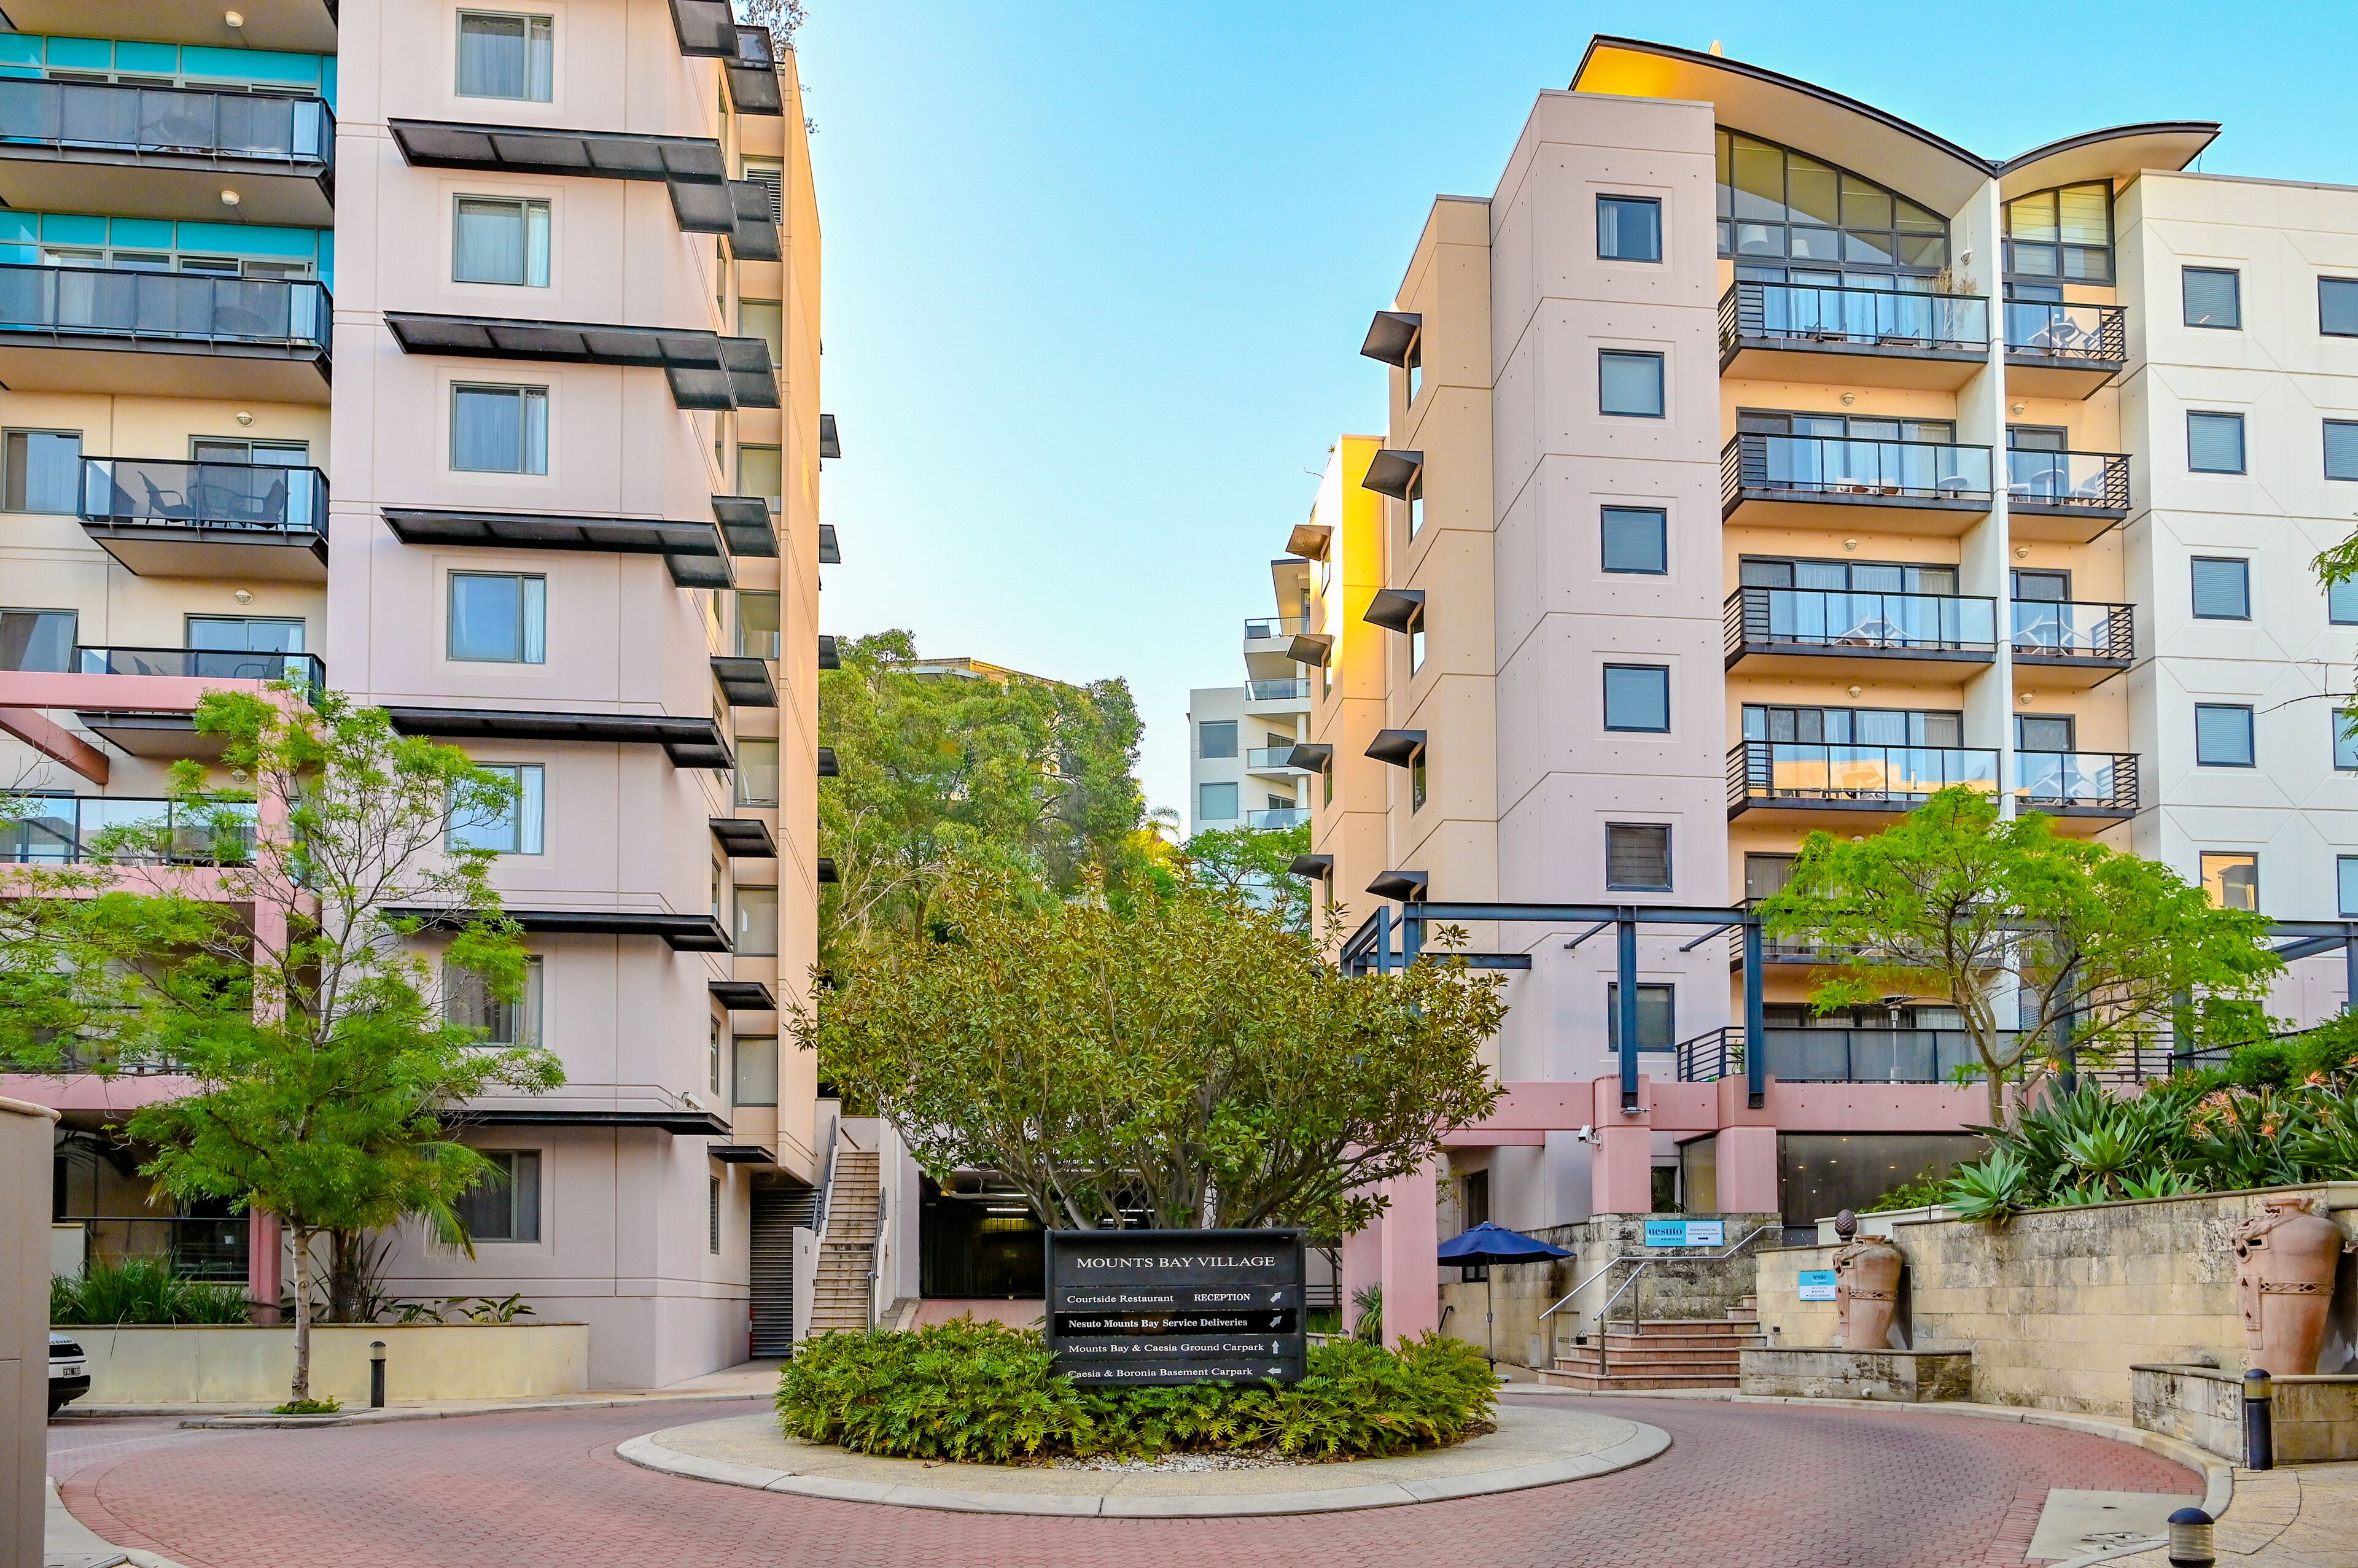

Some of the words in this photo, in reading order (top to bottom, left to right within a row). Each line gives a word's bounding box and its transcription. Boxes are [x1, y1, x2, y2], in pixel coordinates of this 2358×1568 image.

[1649, 1227, 1683, 1235] nesuto
[1076, 1258, 1153, 1268] MOUNTS
[1159, 1257, 1193, 1267] BAY
[1197, 1256, 1275, 1267] VILLAGE
[1067, 1295, 1116, 1303] Courtside
[1068, 1319, 1102, 1328] Nesuto
[1103, 1319, 1138, 1328] Mounts
[1141, 1319, 1159, 1329] Bay
[1162, 1319, 1197, 1327] Service
[1200, 1318, 1248, 1327] Deliveries
[1110, 1345, 1129, 1353] Bay
[1223, 1343, 1264, 1353] Carpark
[1211, 1368, 1253, 1377] Carpark
